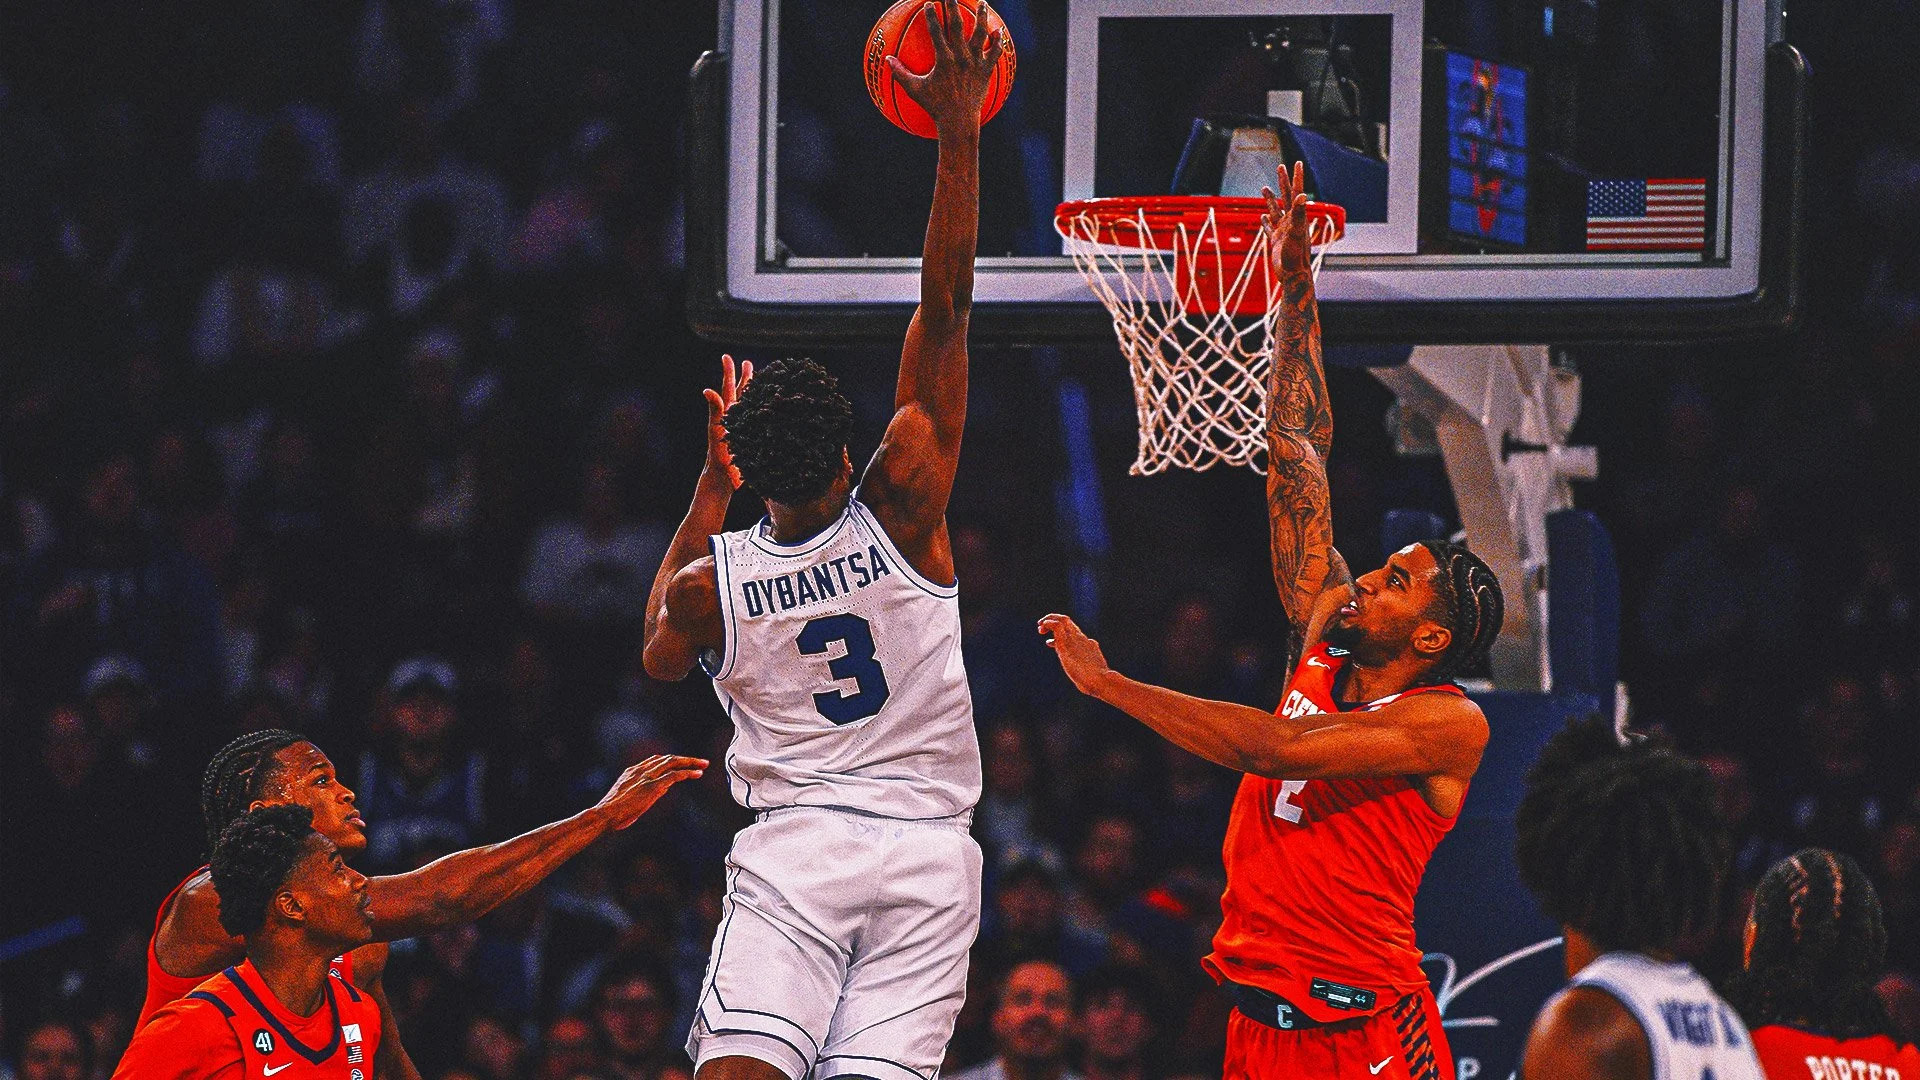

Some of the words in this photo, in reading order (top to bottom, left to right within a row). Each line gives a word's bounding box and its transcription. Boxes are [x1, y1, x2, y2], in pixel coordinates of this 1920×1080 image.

[742, 544, 890, 618] DYBANTSA
[796, 612, 890, 726] 3
[1277, 1004, 1293, 1029] C
[255, 1032, 273, 1052] 41
